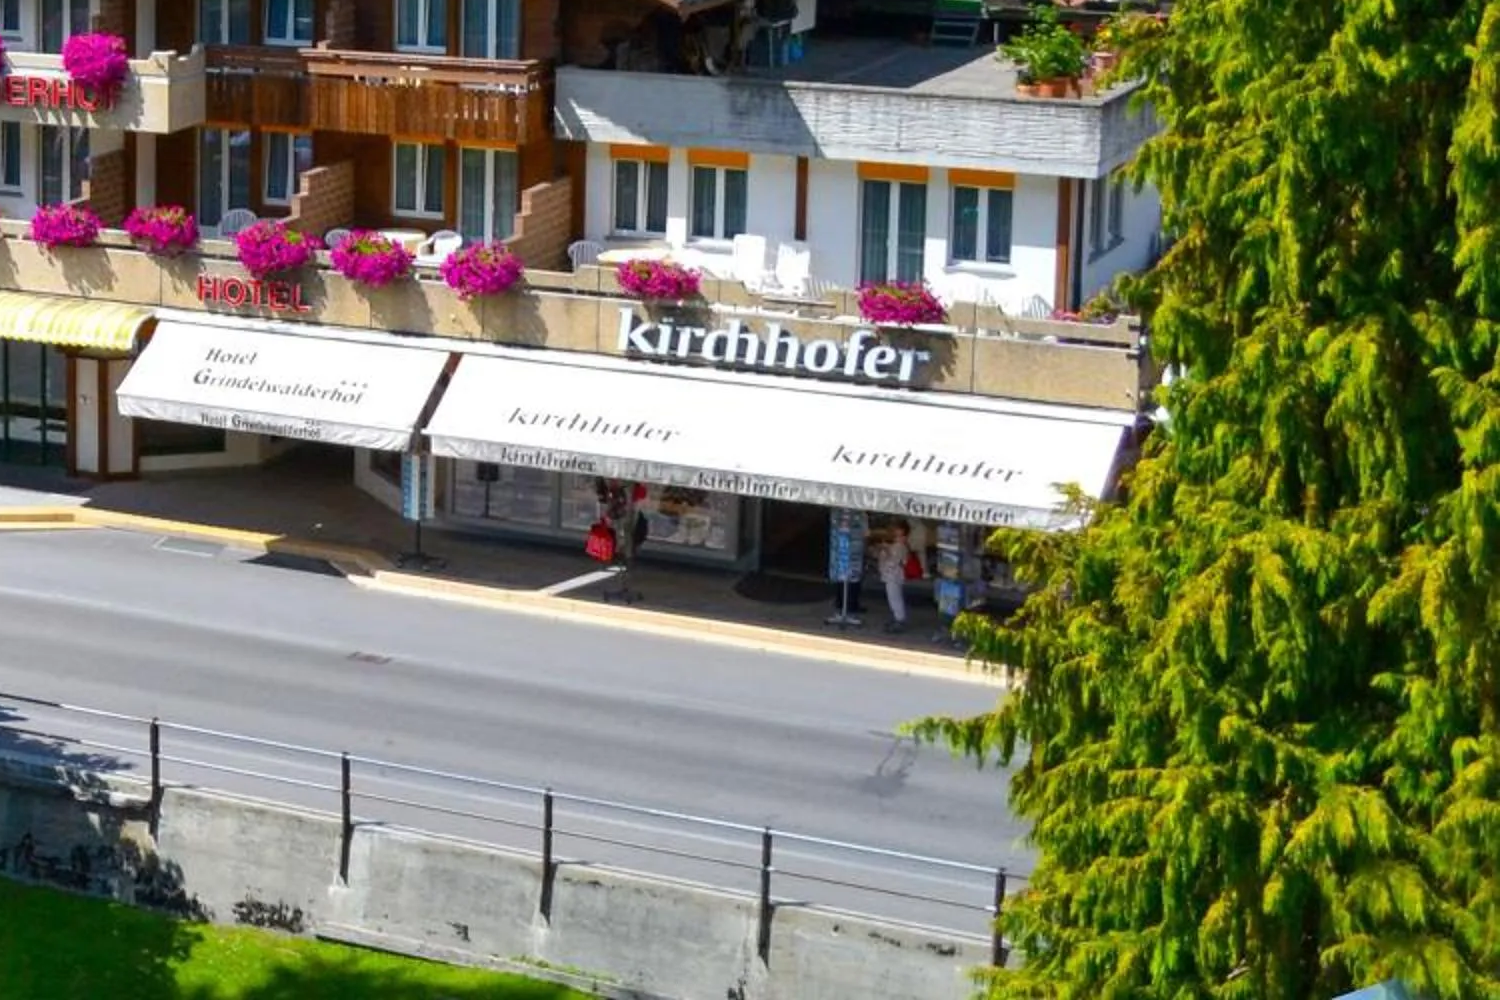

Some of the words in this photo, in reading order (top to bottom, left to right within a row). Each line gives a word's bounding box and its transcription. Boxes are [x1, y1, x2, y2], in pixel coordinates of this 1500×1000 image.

[197, 275, 309, 312] HOTEL
[205, 347, 258, 365] Hotel
[193, 367, 364, 404] Grindelwalderhof
[508, 406, 683, 442] kirchhofer
[831, 444, 1025, 483] kirchhofer
